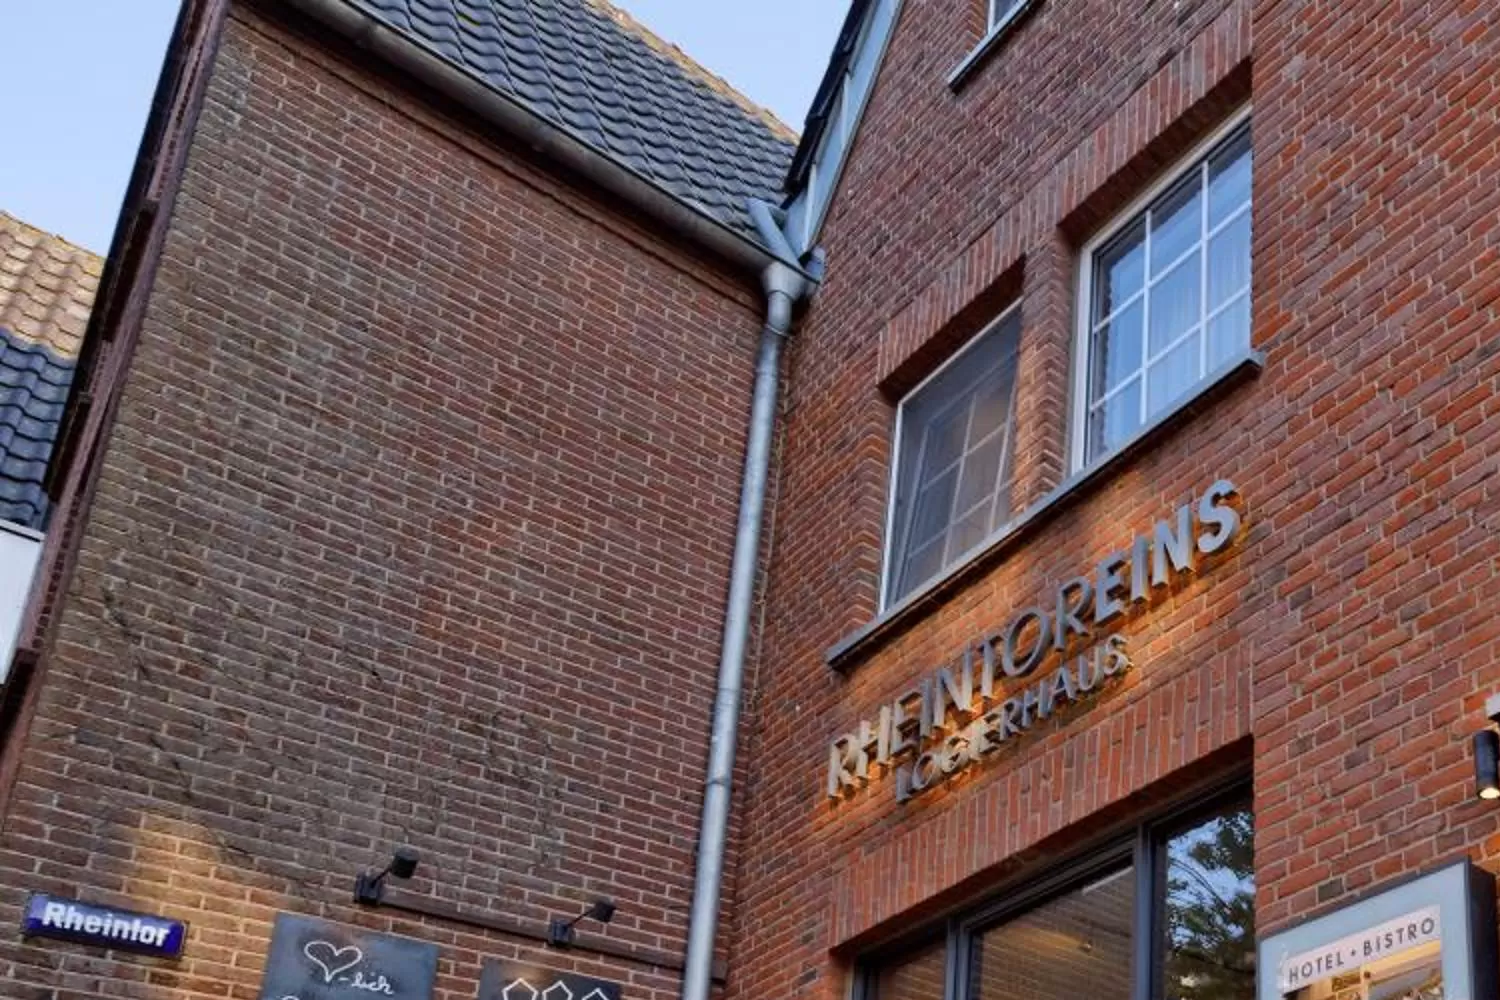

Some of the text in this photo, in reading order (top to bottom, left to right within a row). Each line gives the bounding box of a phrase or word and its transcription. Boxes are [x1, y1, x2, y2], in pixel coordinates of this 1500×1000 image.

[826, 479, 1246, 800] RHEINTOREINS
[895, 632, 1134, 802] LOGIERHAUS
[41, 900, 171, 948] Rheintor
[1288, 917, 1436, 984] HOTEL BISTRO
